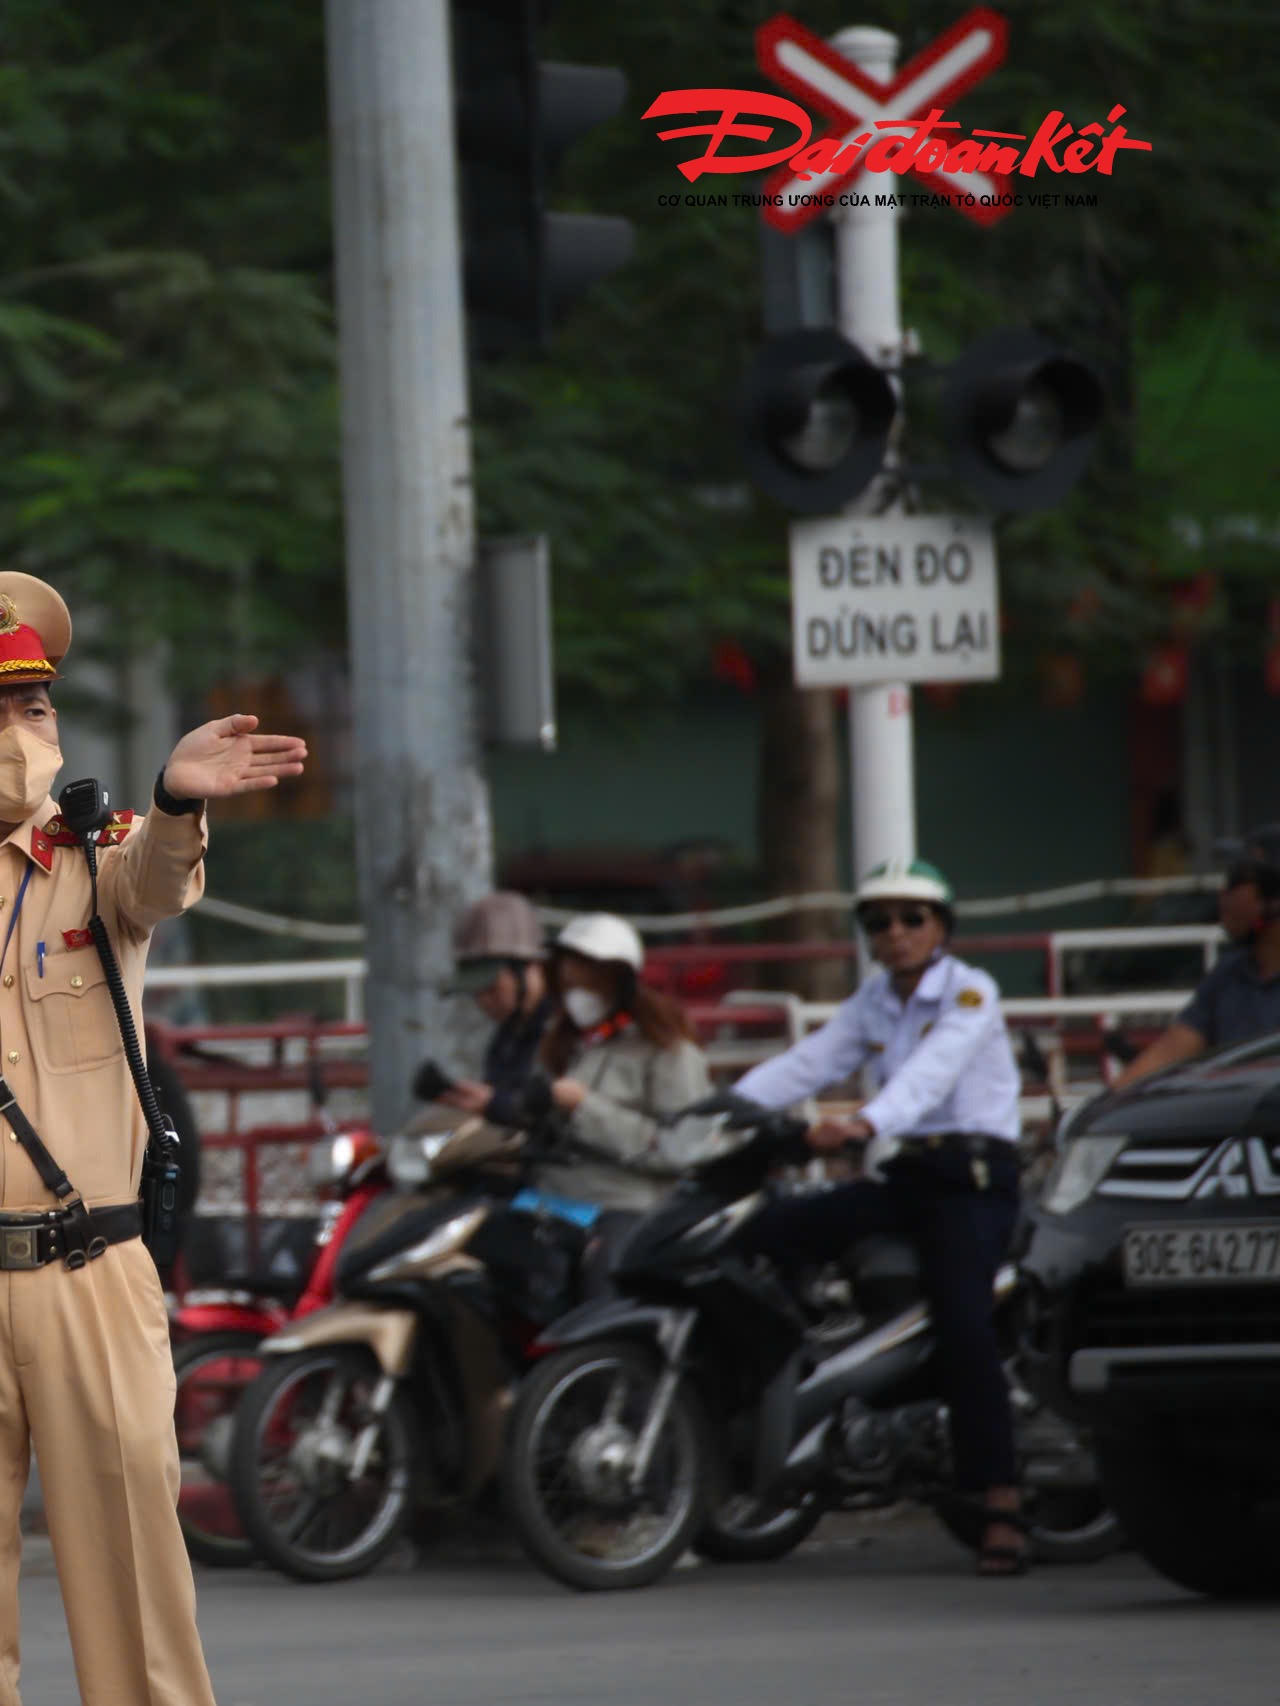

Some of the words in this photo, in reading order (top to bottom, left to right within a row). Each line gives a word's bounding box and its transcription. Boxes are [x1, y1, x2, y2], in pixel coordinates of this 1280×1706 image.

[817, 527, 903, 588] ĐÈN
[914, 519, 972, 587] ĐỎ
[930, 610, 990, 663] LẠI
